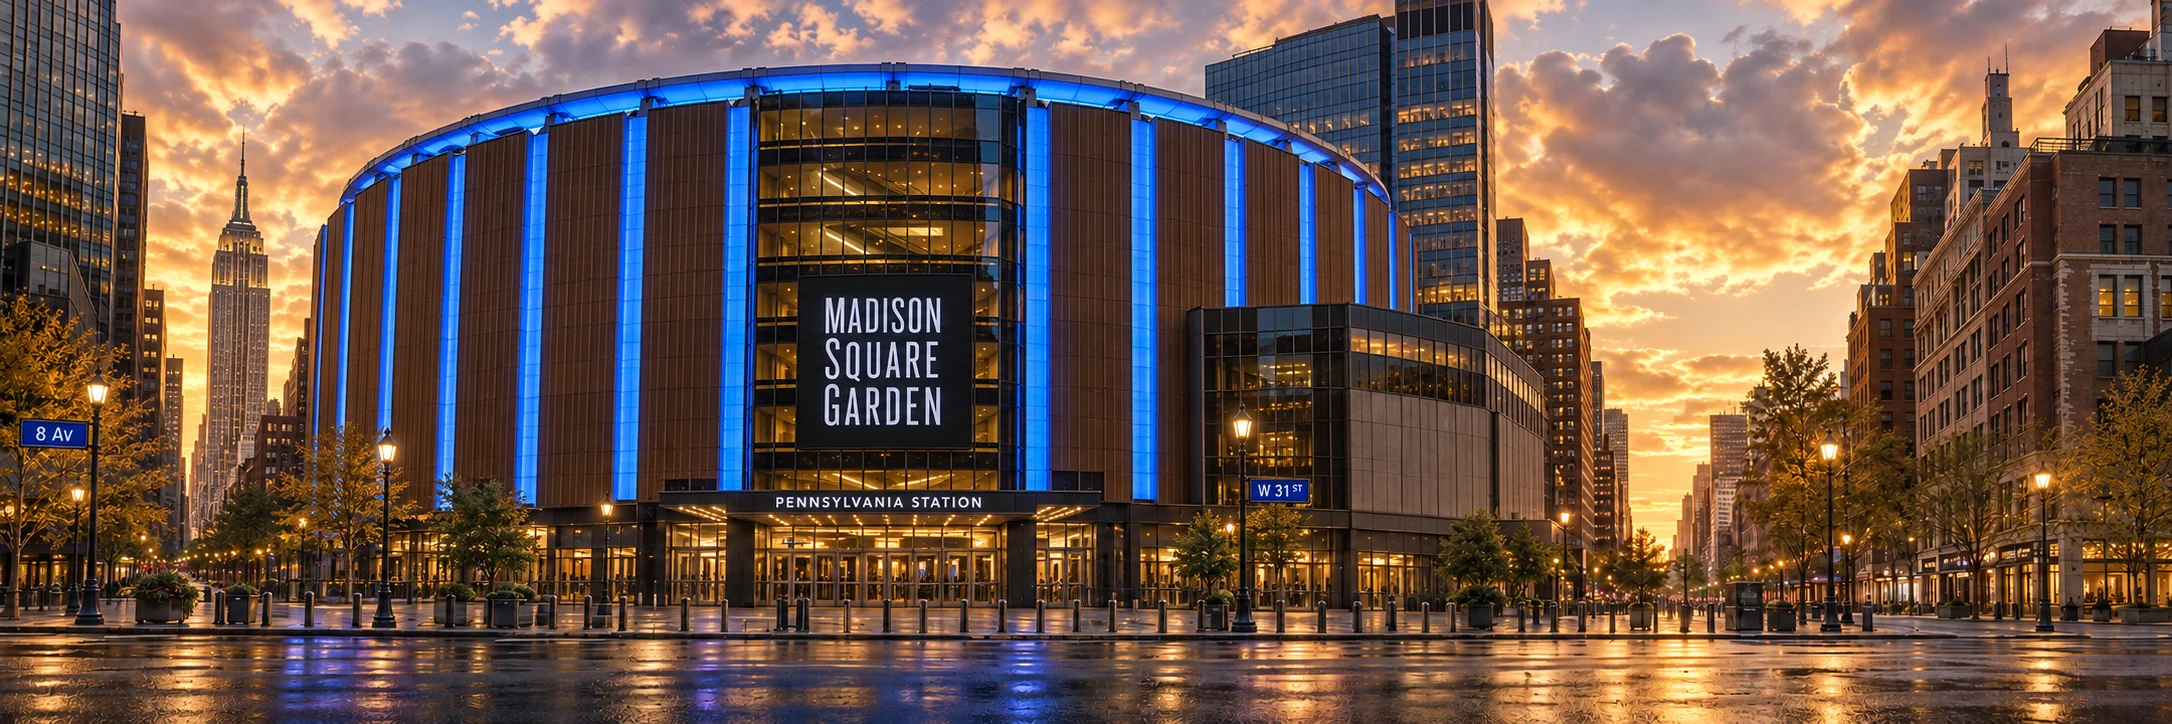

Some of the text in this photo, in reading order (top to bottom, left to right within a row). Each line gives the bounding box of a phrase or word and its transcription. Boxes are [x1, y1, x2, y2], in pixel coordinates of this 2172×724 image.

[824, 297, 941, 334] MADISON
[824, 337, 939, 382] SQUARE
[824, 383, 941, 427] GARDEN
[35, 426, 74, 442] 8 Av
[775, 496, 983, 509] PENNSYLVANIA STATION
[1257, 484, 1271, 498] W
